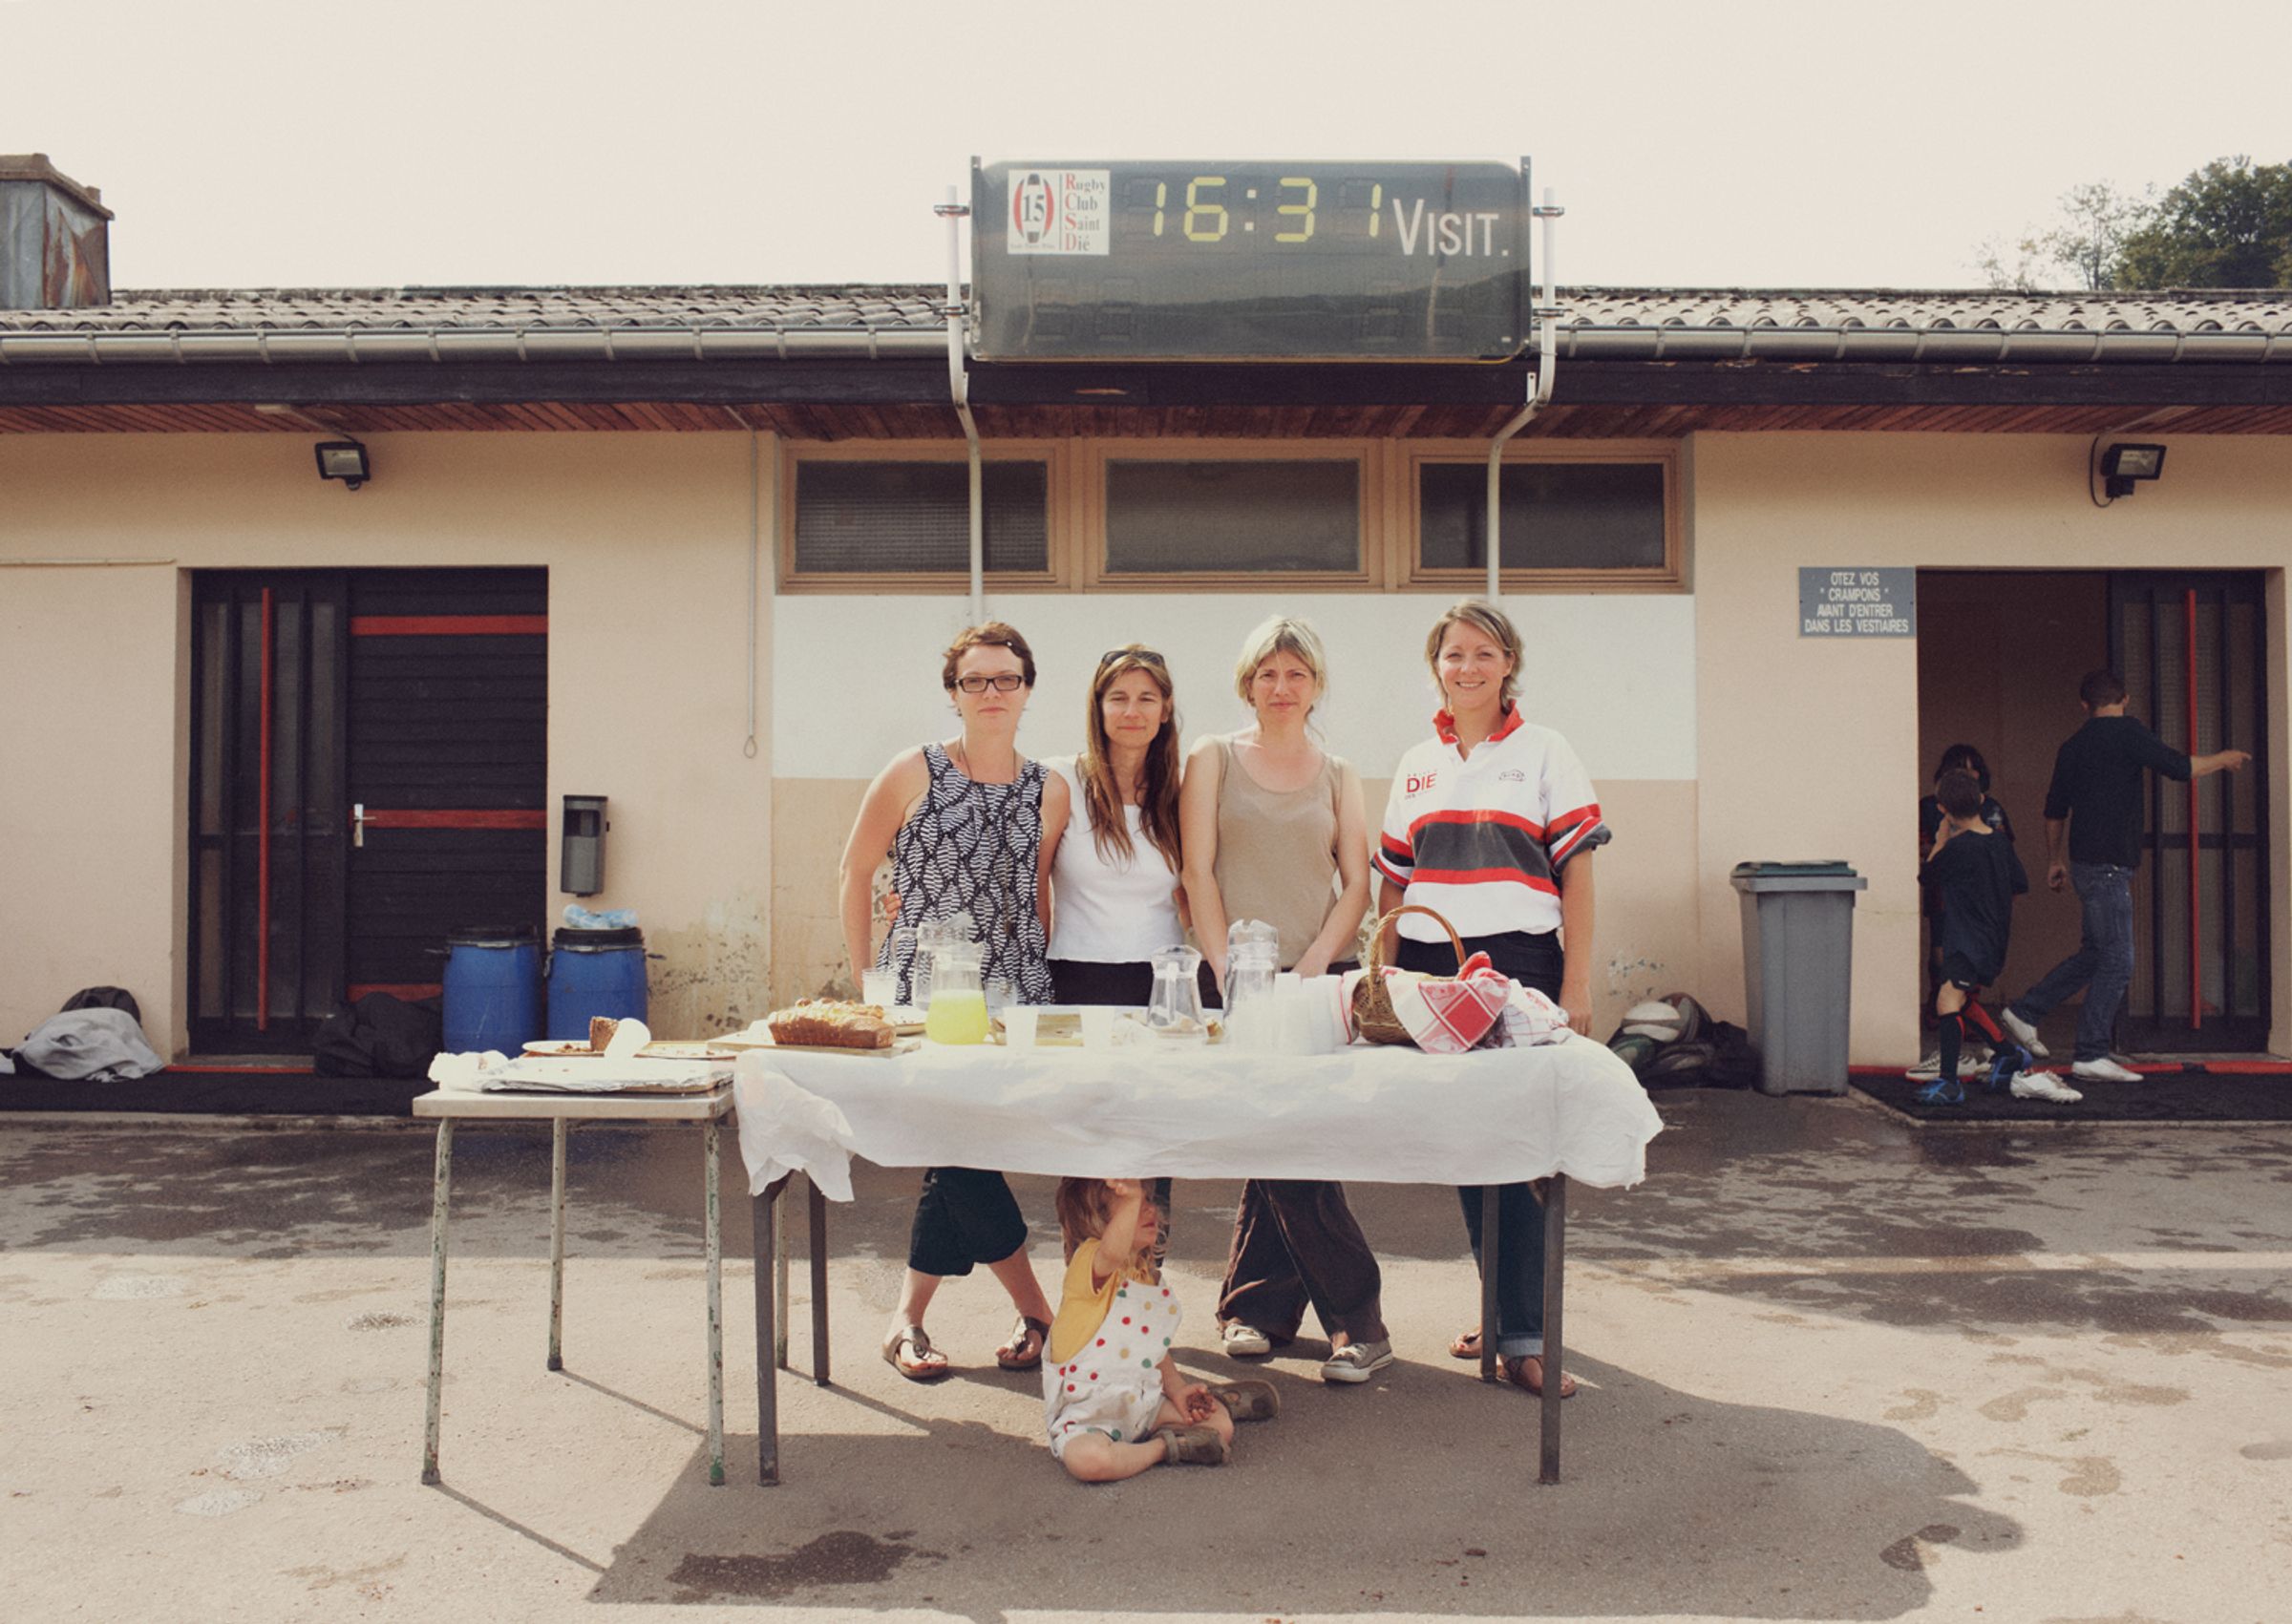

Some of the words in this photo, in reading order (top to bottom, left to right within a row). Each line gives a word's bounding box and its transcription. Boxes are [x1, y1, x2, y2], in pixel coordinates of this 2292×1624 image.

[1065, 173, 1106, 194] Rugby
[1023, 194, 1045, 222] 15
[1065, 192, 1098, 211] Club
[1065, 213, 1101, 231] Saint
[1065, 233, 1091, 251] Dié
[1830, 572, 1856, 585] OTEZ
[1859, 572, 1879, 585] VOS
[1816, 603, 1845, 618] AVANT
[1849, 603, 1894, 618] D'ENTRER
[1804, 618, 1831, 633] DANS
[1834, 618, 1853, 633] LES
[1856, 618, 1909, 633] VESTIAIRES
